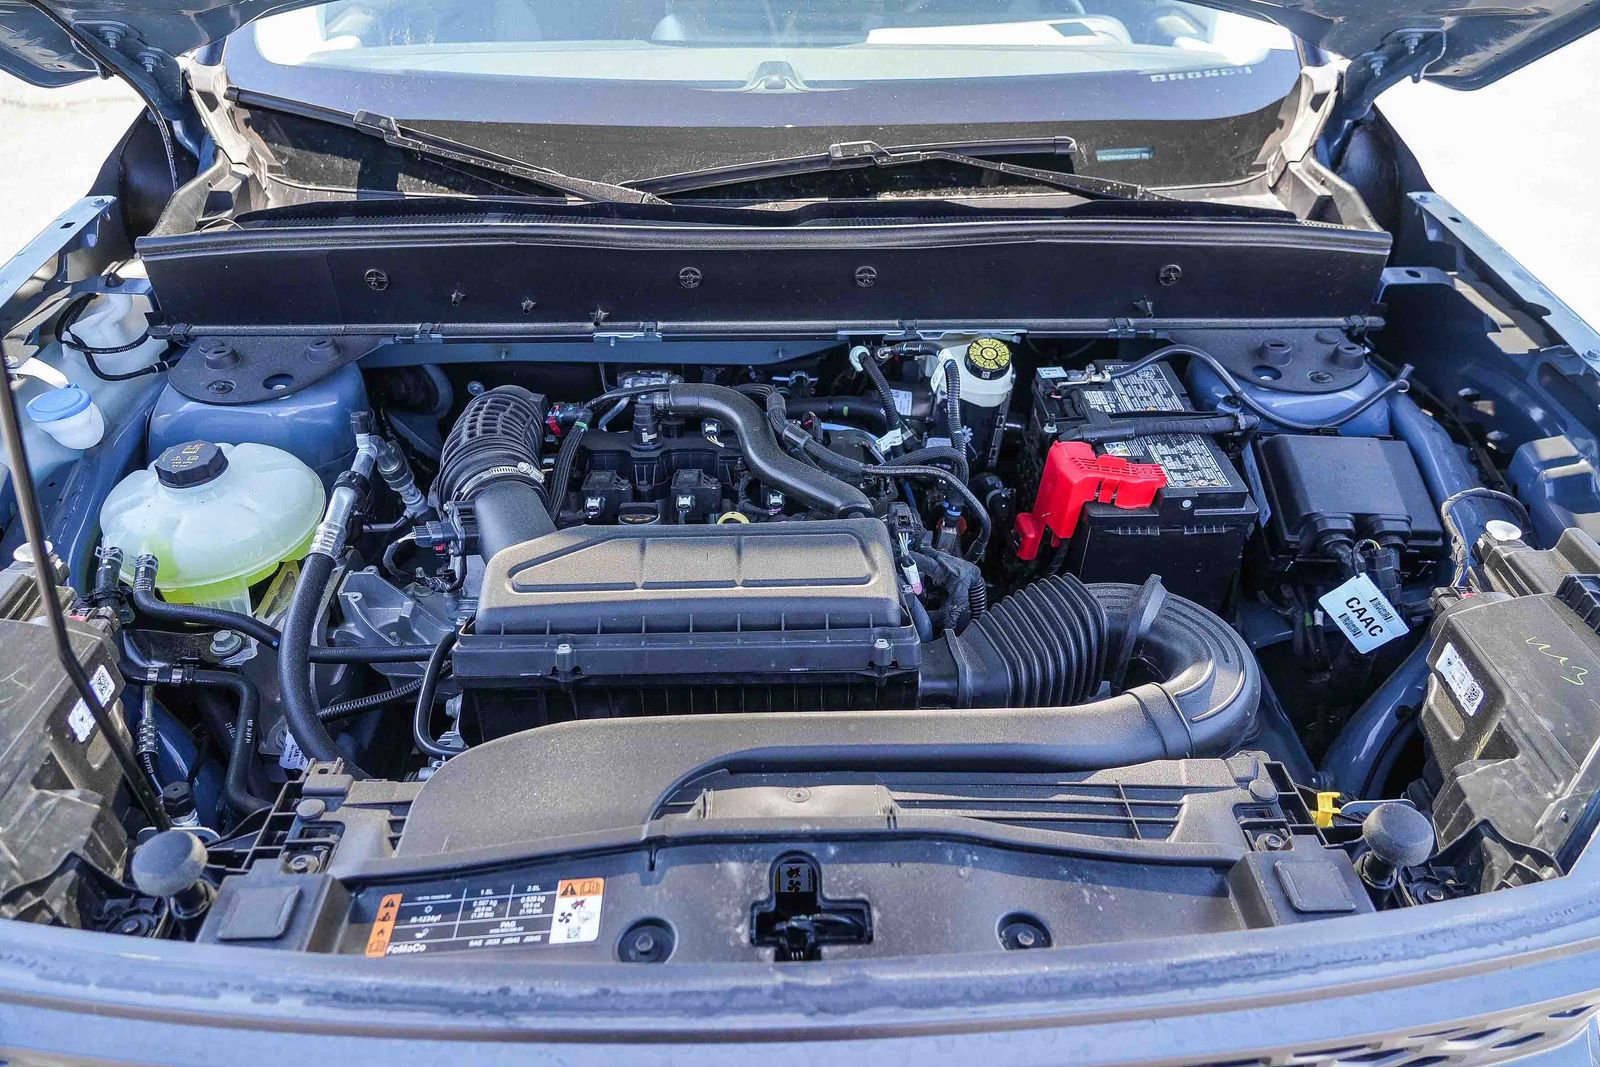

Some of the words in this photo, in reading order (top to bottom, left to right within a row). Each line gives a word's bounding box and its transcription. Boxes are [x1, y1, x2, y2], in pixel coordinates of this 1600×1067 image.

[1345, 596, 1384, 637] CAAC
[410, 914, 442, 924] R-1234yf
[387, 943, 426, 954] FoMoCo
